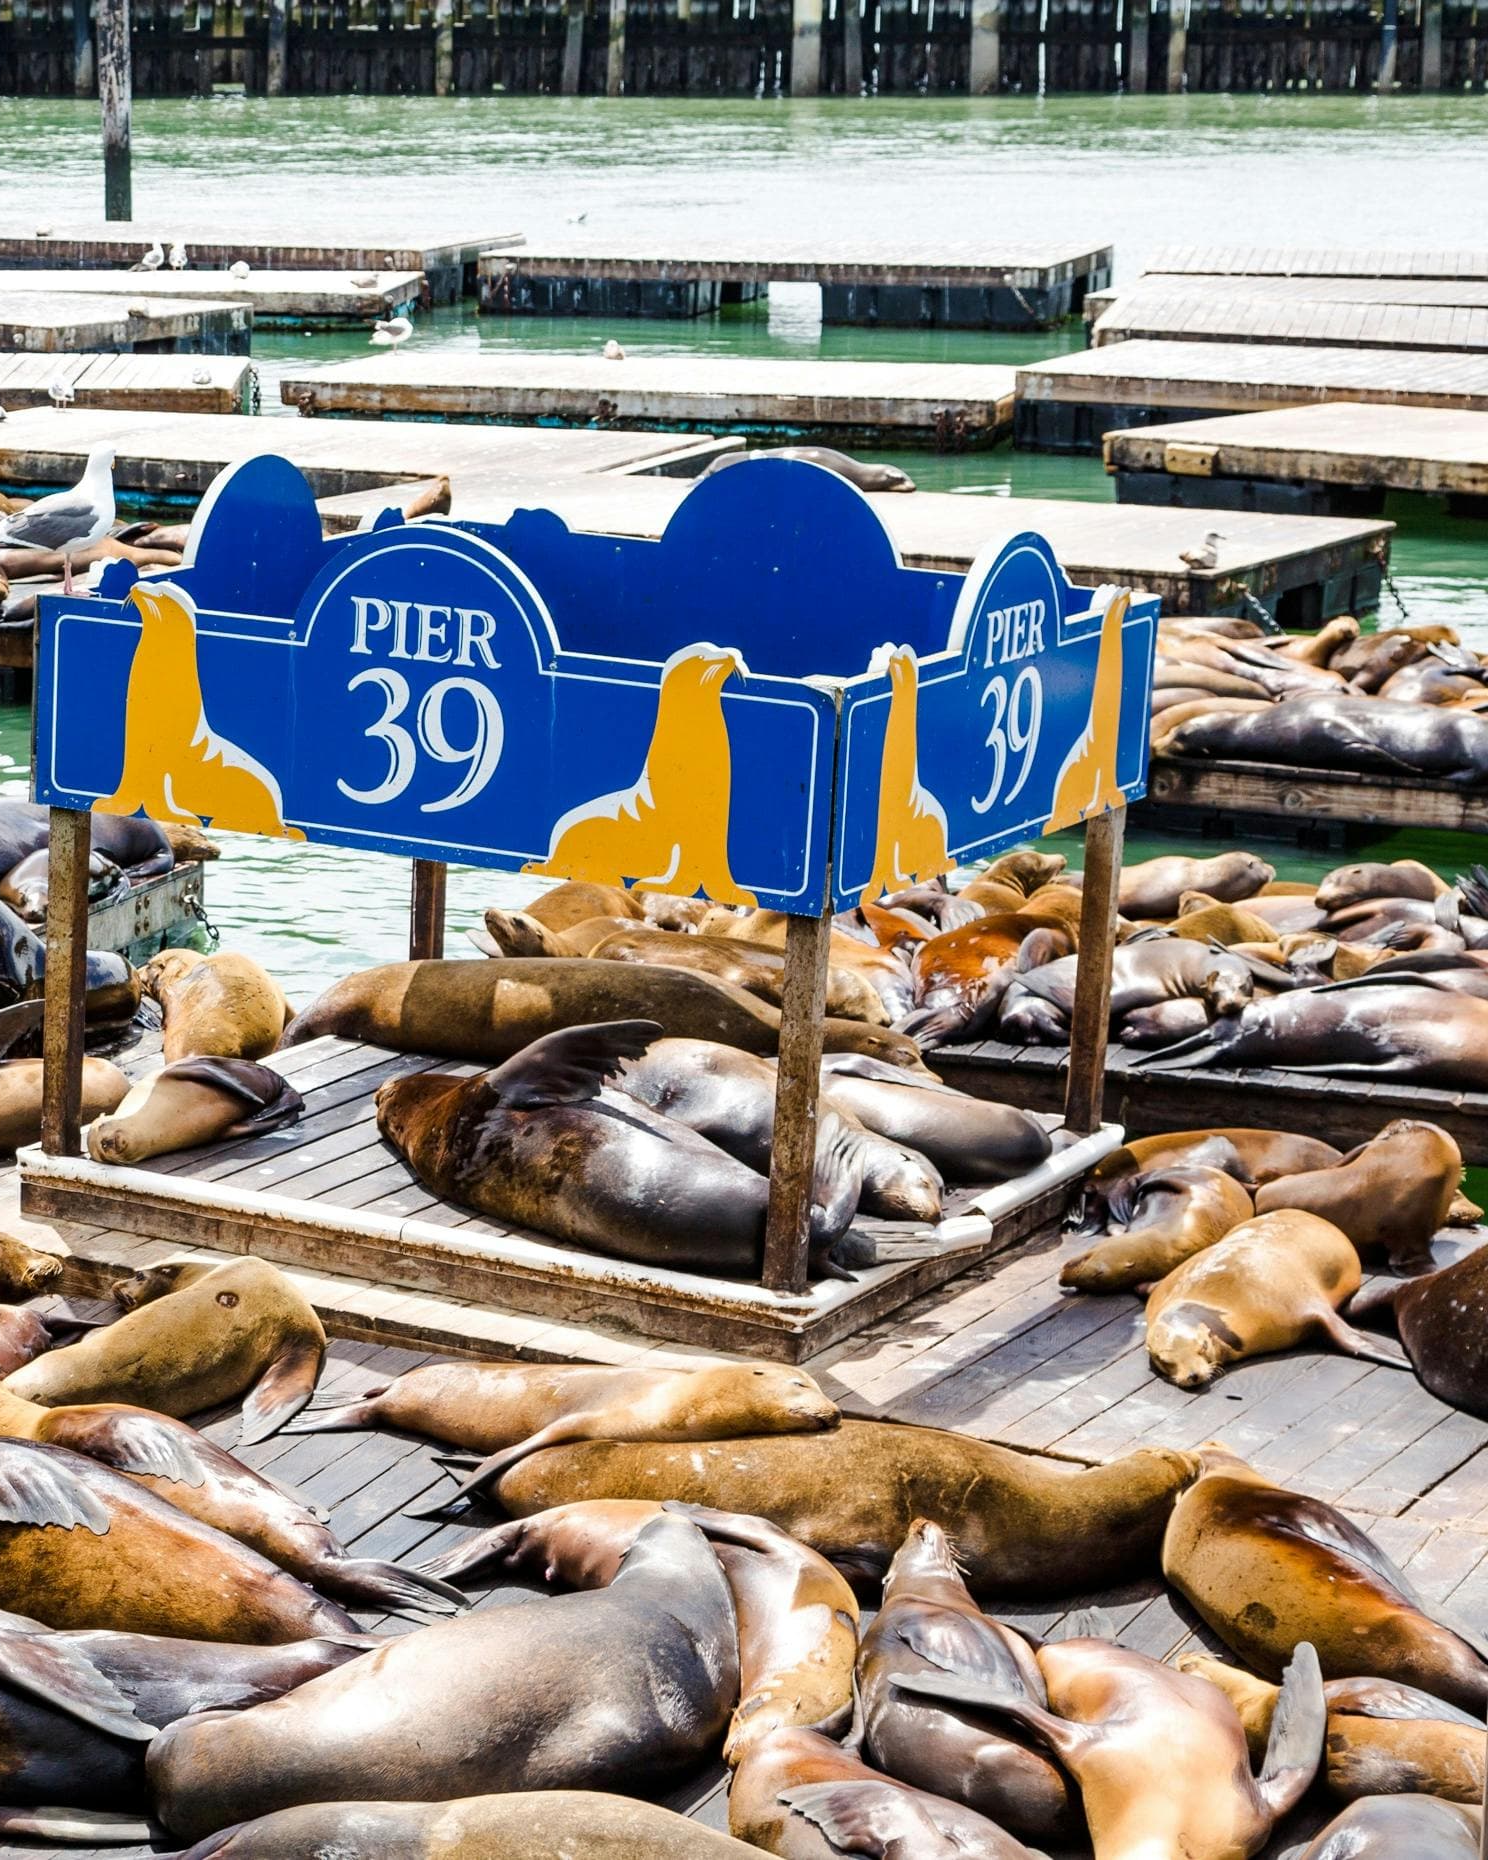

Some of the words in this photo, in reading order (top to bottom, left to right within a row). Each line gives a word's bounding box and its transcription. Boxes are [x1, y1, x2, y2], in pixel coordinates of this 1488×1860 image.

[349, 596, 502, 669] PIER
[984, 599, 1045, 669] PIER
[336, 667, 504, 812] 39
[971, 666, 1043, 814] 39
